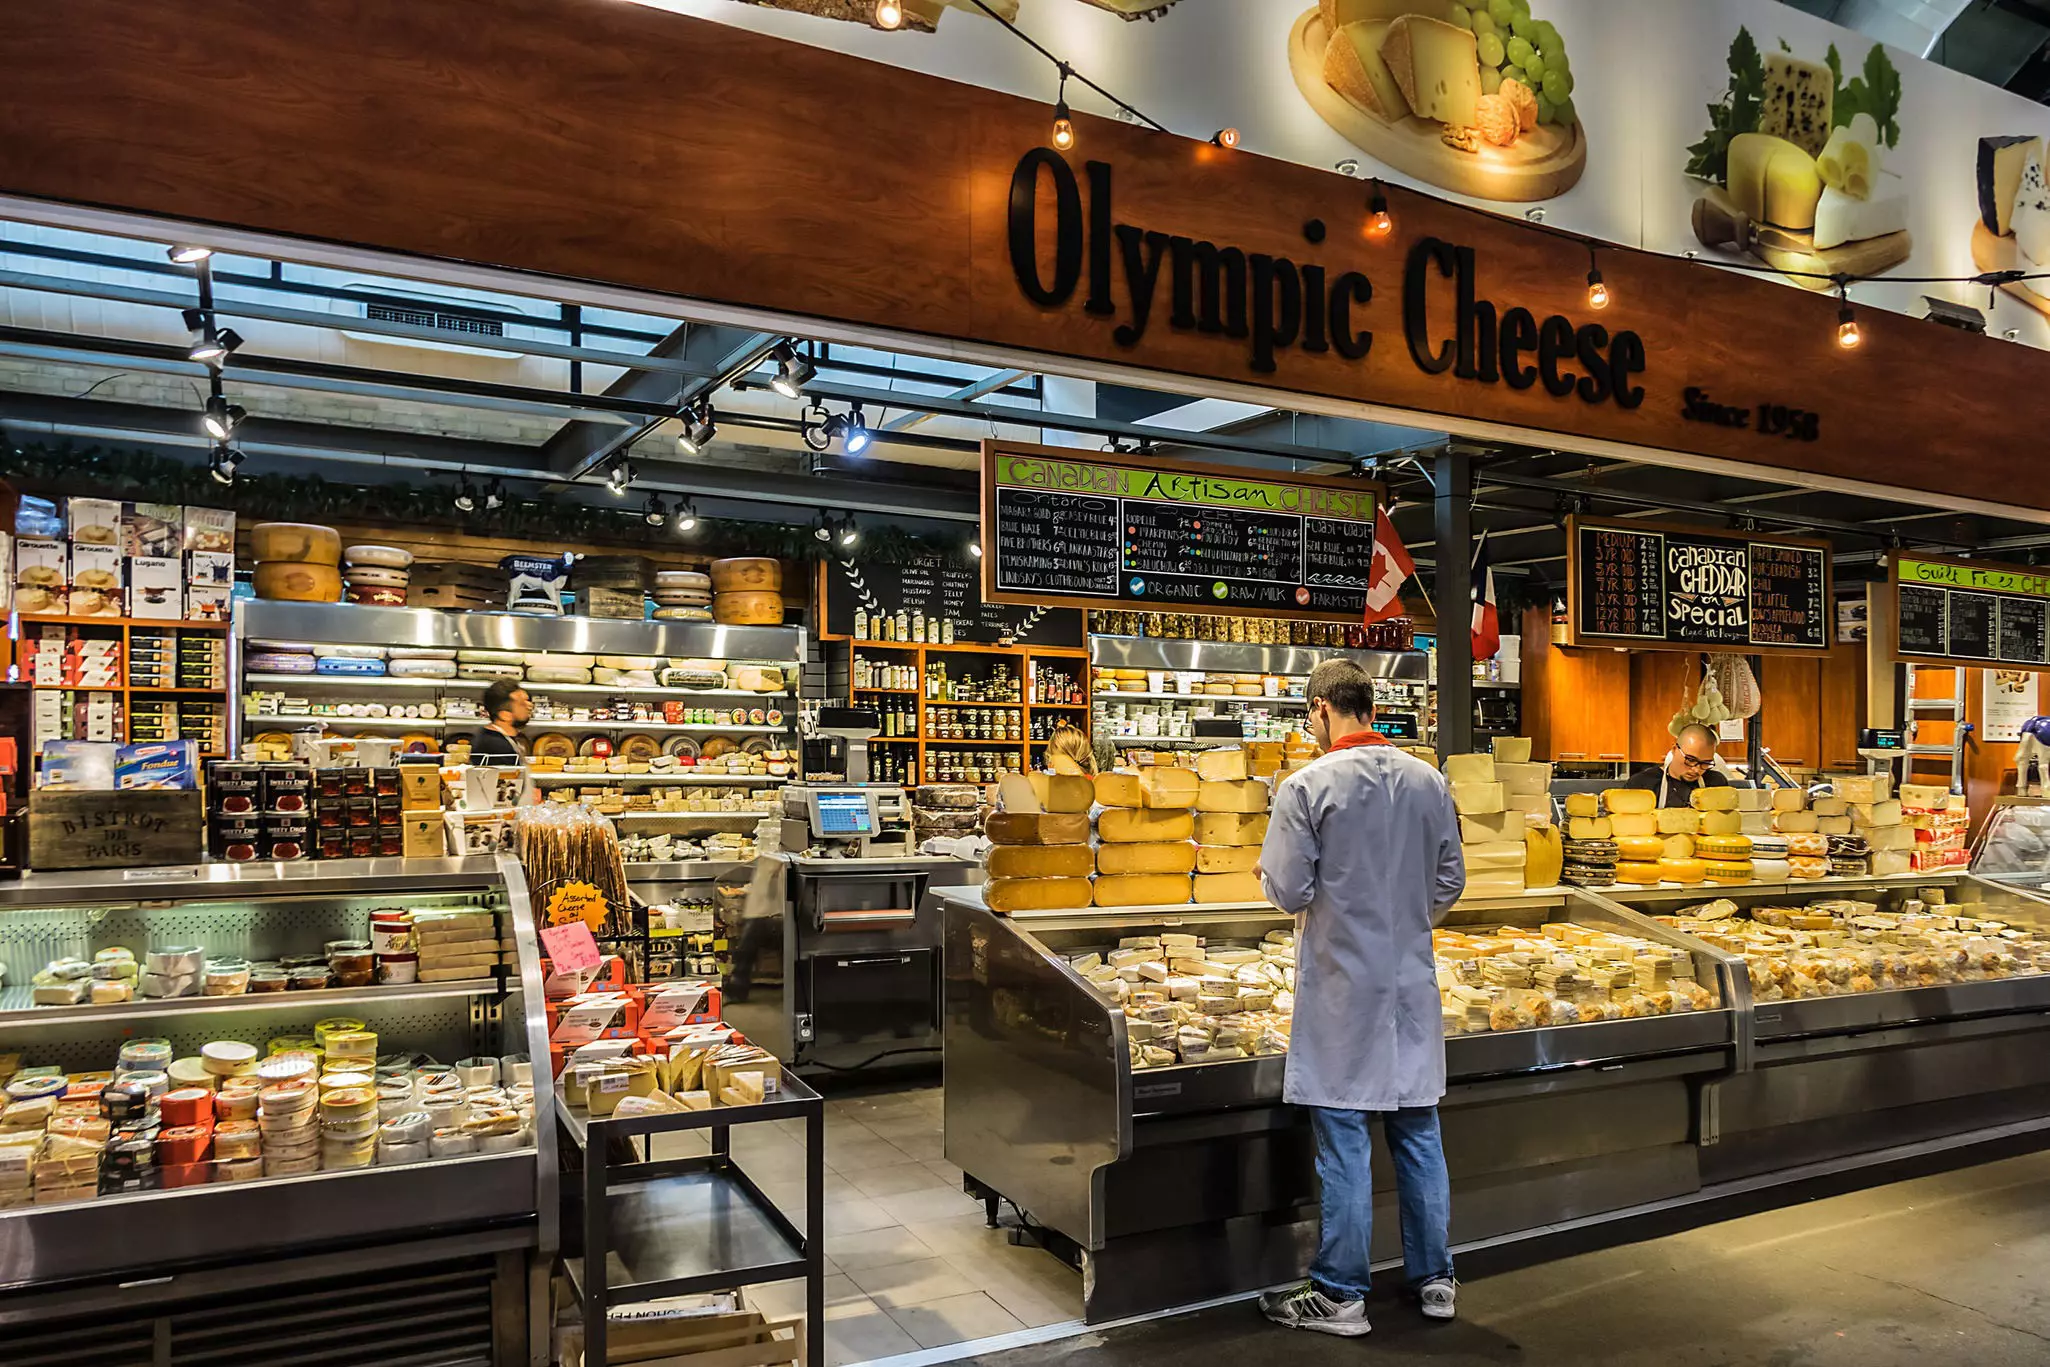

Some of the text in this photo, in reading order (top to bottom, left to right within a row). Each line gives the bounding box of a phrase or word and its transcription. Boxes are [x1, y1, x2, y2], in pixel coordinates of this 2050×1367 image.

[1007, 147, 1647, 410] Olympic Cheese
[1681, 386, 1819, 442] Since 1958
[1279, 487, 1367, 520] CHEESE
[1596, 532, 1636, 548] MEDIUM
[135, 559, 166, 568] Lugano
[514, 560, 552, 570] BEEMSTER
[1605, 563, 1619, 576] YR
[1680, 564, 1746, 597] CHEDDAR
[1916, 563, 1961, 585] Guilt
[902, 578, 935, 586] MARINADES
[942, 581, 970, 589] CHUTNEY
[1606, 577, 1619, 591] YR
[943, 590, 964, 598] JELLY
[1147, 581, 1204, 598] ORGANIC
[1230, 585, 1257, 600] RAW
[1259, 587, 1286, 601] MILK
[903, 597, 926, 605] RELISH
[1607, 593, 1621, 606] YR
[944, 609, 961, 617] JAM
[1607, 607, 1619, 621] YR
[1608, 622, 1620, 633] YR
[141, 759, 180, 771] Fondue
[61, 810, 169, 836] BISTROT
[104, 829, 127, 841] DE
[87, 843, 143, 858] PARIS
